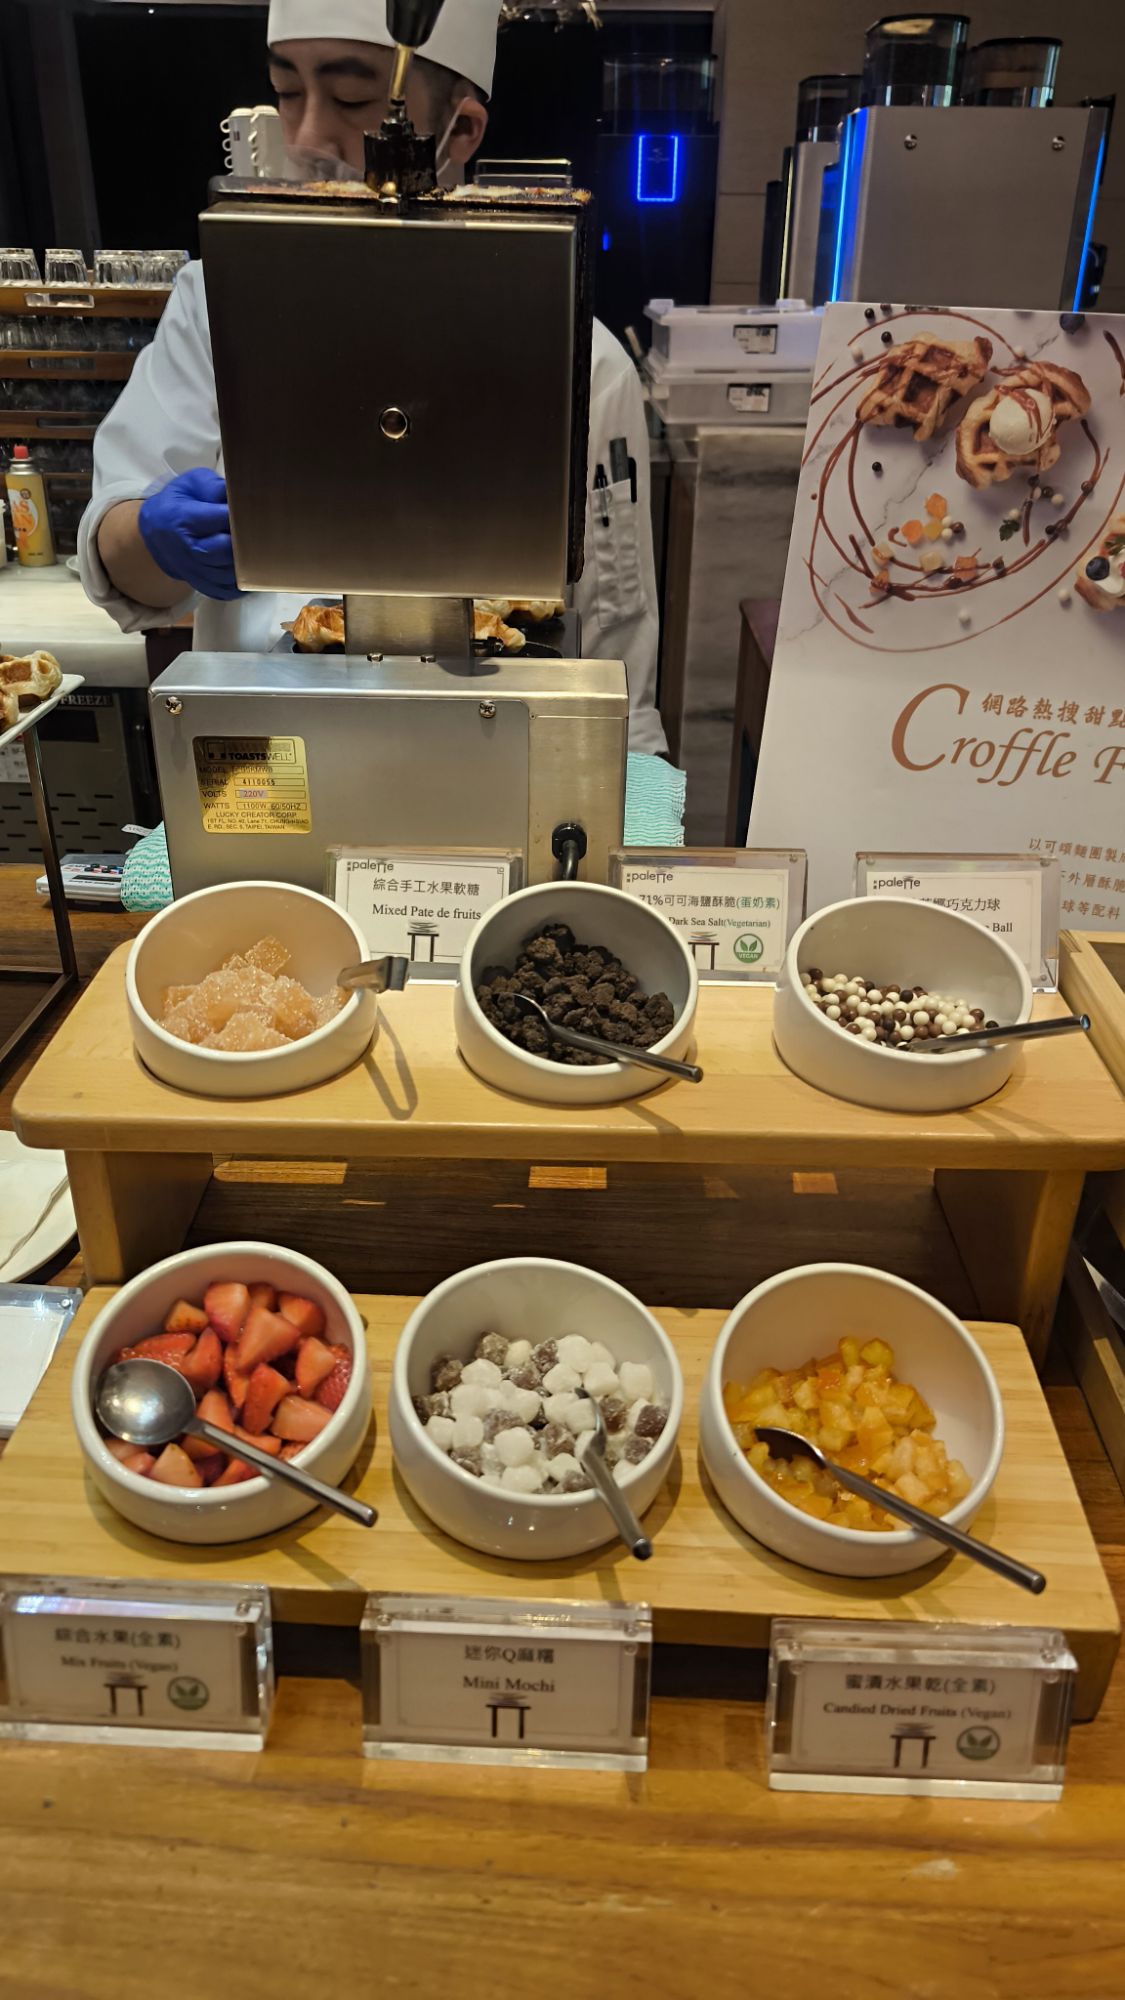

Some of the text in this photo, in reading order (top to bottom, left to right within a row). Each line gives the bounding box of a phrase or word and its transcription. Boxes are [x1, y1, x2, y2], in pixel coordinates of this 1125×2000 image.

[892, 683, 1077, 787] Croffle
[201, 790, 264, 798] VOLTS 220V
[203, 802, 230, 810] WATTS
[373, 877, 480, 896] 綜合手工水果軟糖
[372, 904, 482, 920] Mixed Pate de fruits
[691, 917, 706, 926] Sea
[992, 923, 1013, 933] Ball
[61, 1656, 179, 1673] Mix Fruits (Vegan)
[463, 1676, 555, 1693] Mini Mochi
[823, 1702, 1012, 1721] Candied Dried Fruits (Vegan)
